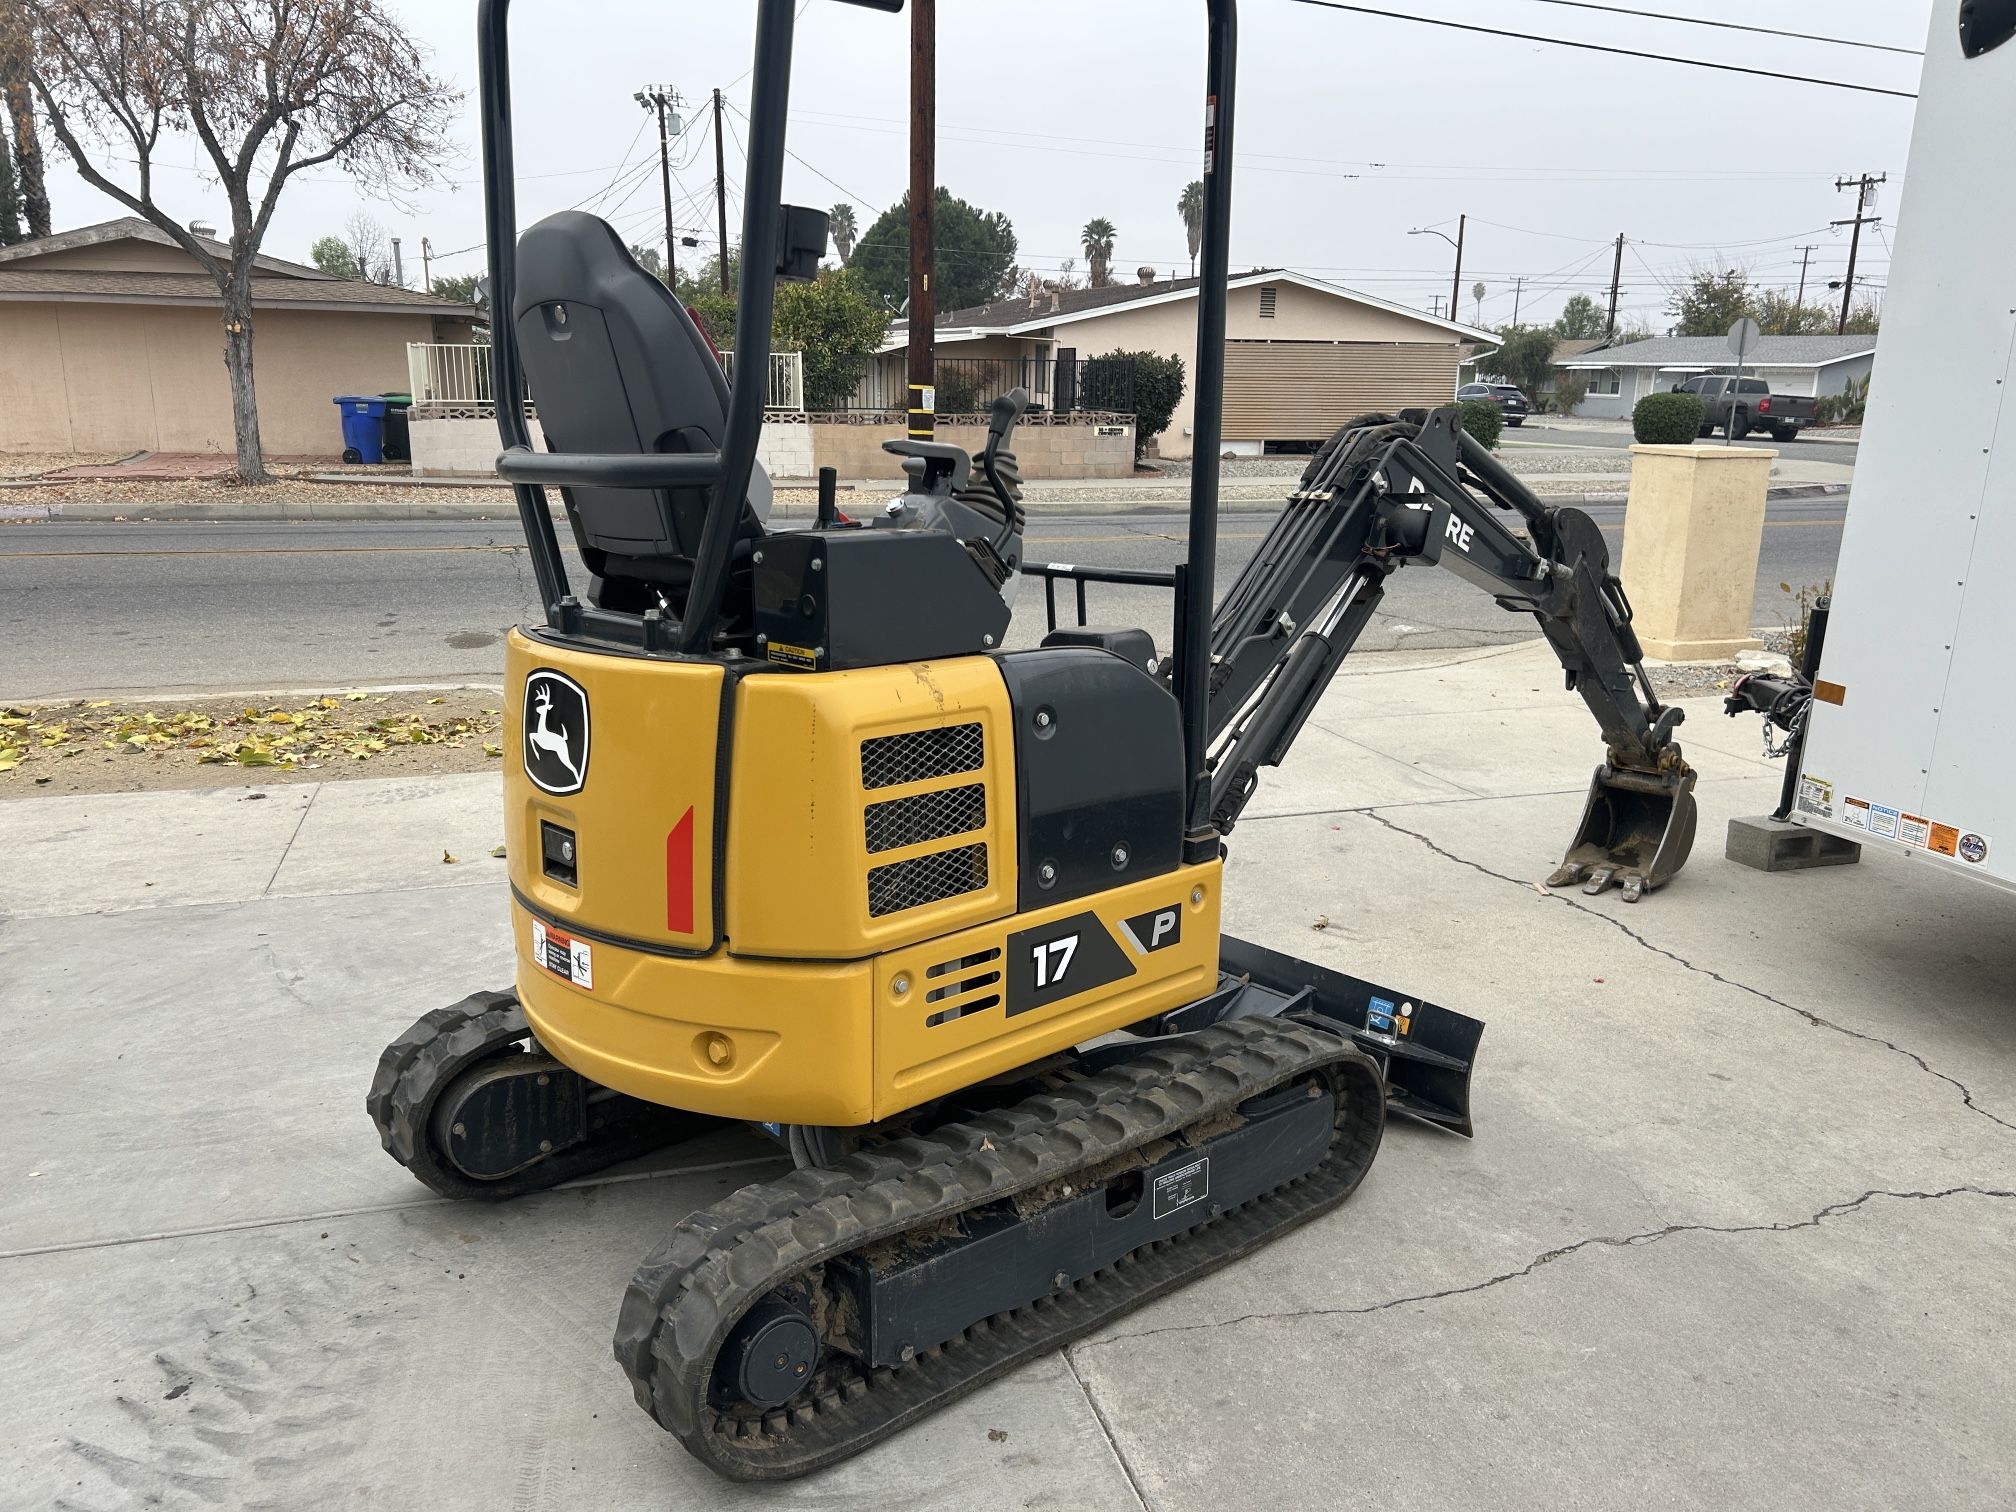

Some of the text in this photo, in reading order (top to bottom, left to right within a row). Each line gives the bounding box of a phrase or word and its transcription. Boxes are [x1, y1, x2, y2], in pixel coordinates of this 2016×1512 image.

[1872, 805, 1898, 816] NOTICE
[1901, 813, 1929, 825] CAUTION
[1151, 911, 1176, 947] P
[1033, 935, 1079, 987] 17
